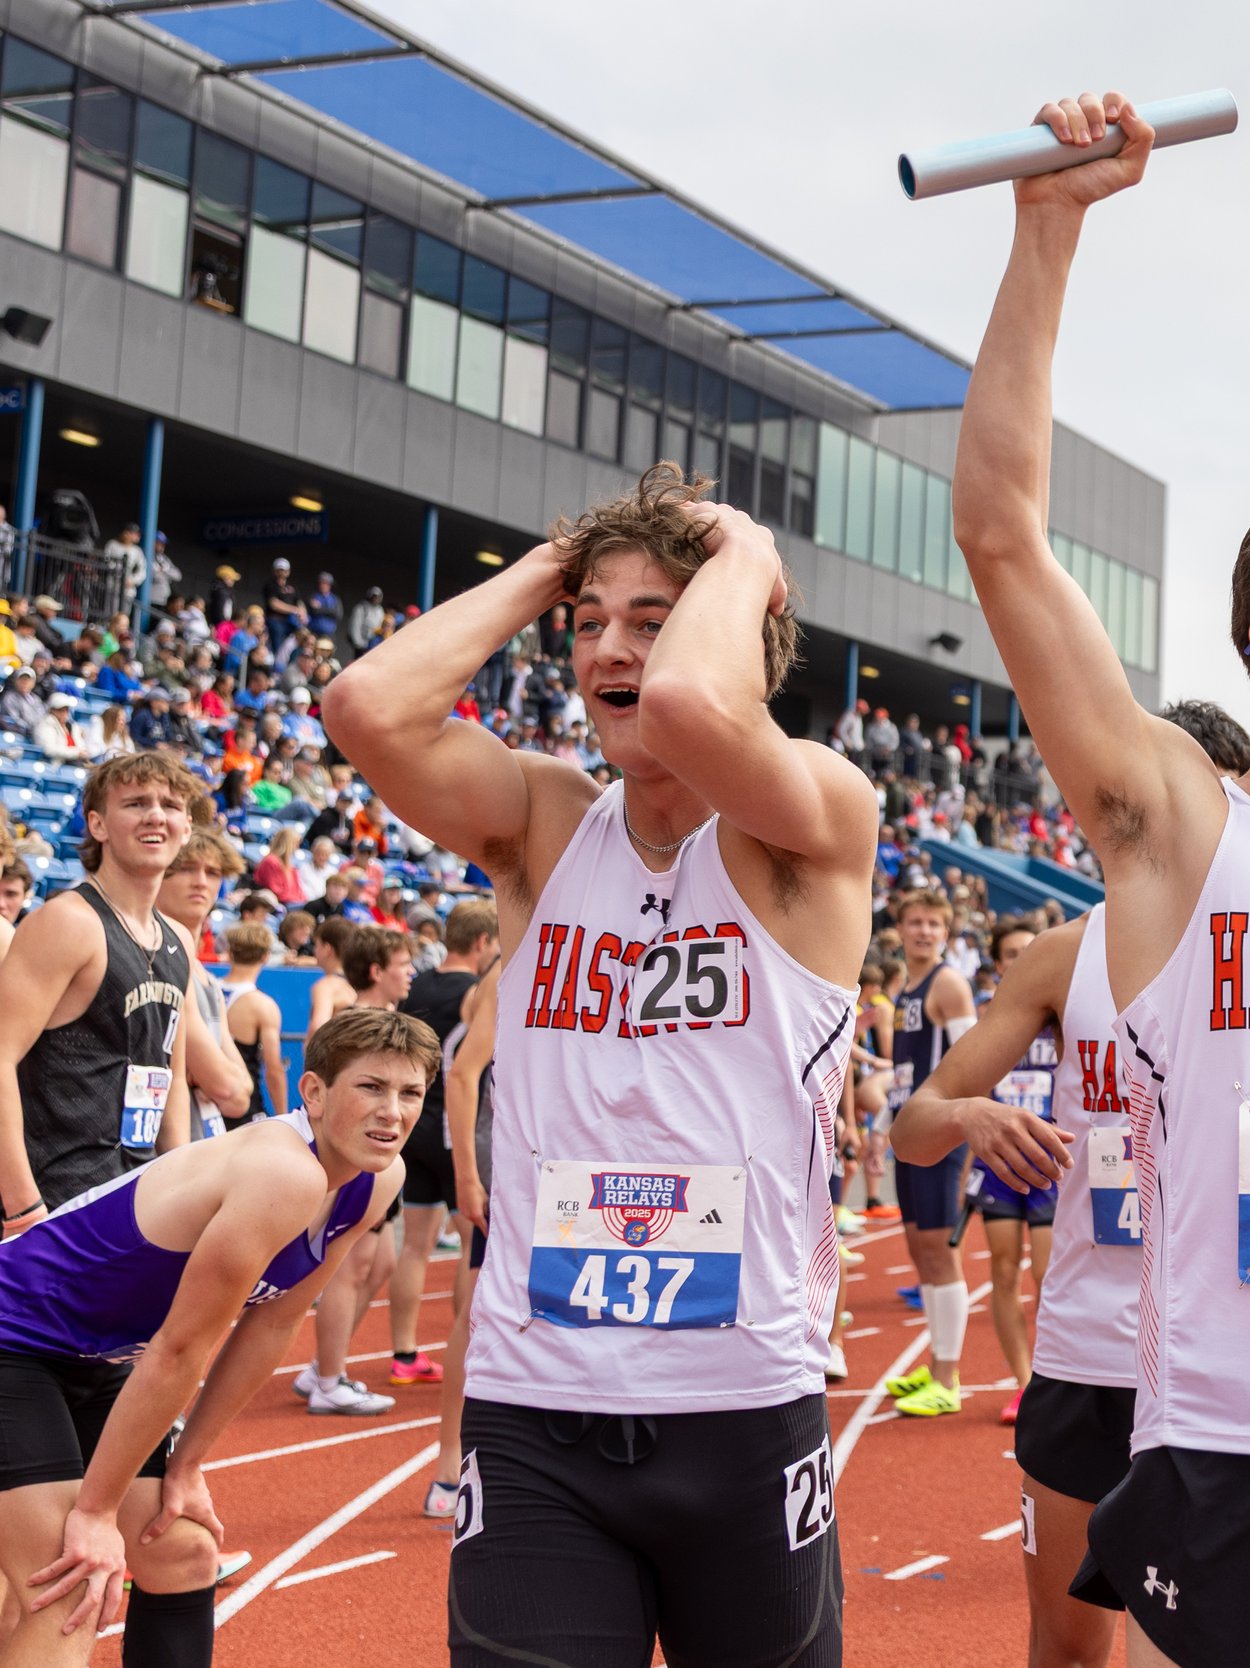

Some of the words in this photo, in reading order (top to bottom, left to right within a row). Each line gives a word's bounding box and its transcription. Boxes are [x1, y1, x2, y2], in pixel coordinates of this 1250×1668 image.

[204, 517, 321, 540] CONCESSIONS
[640, 941, 729, 1021] 25
[1077, 1039, 1131, 1113] HA
[1101, 1154, 1117, 1163] RCB
[604, 1175, 676, 1192] KANSAS
[557, 1200, 580, 1211] RCB
[604, 1190, 673, 1207] RELAYS
[624, 1208, 651, 1218] 2025
[569, 1254, 695, 1324] 437
[790, 1450, 832, 1544] 25
